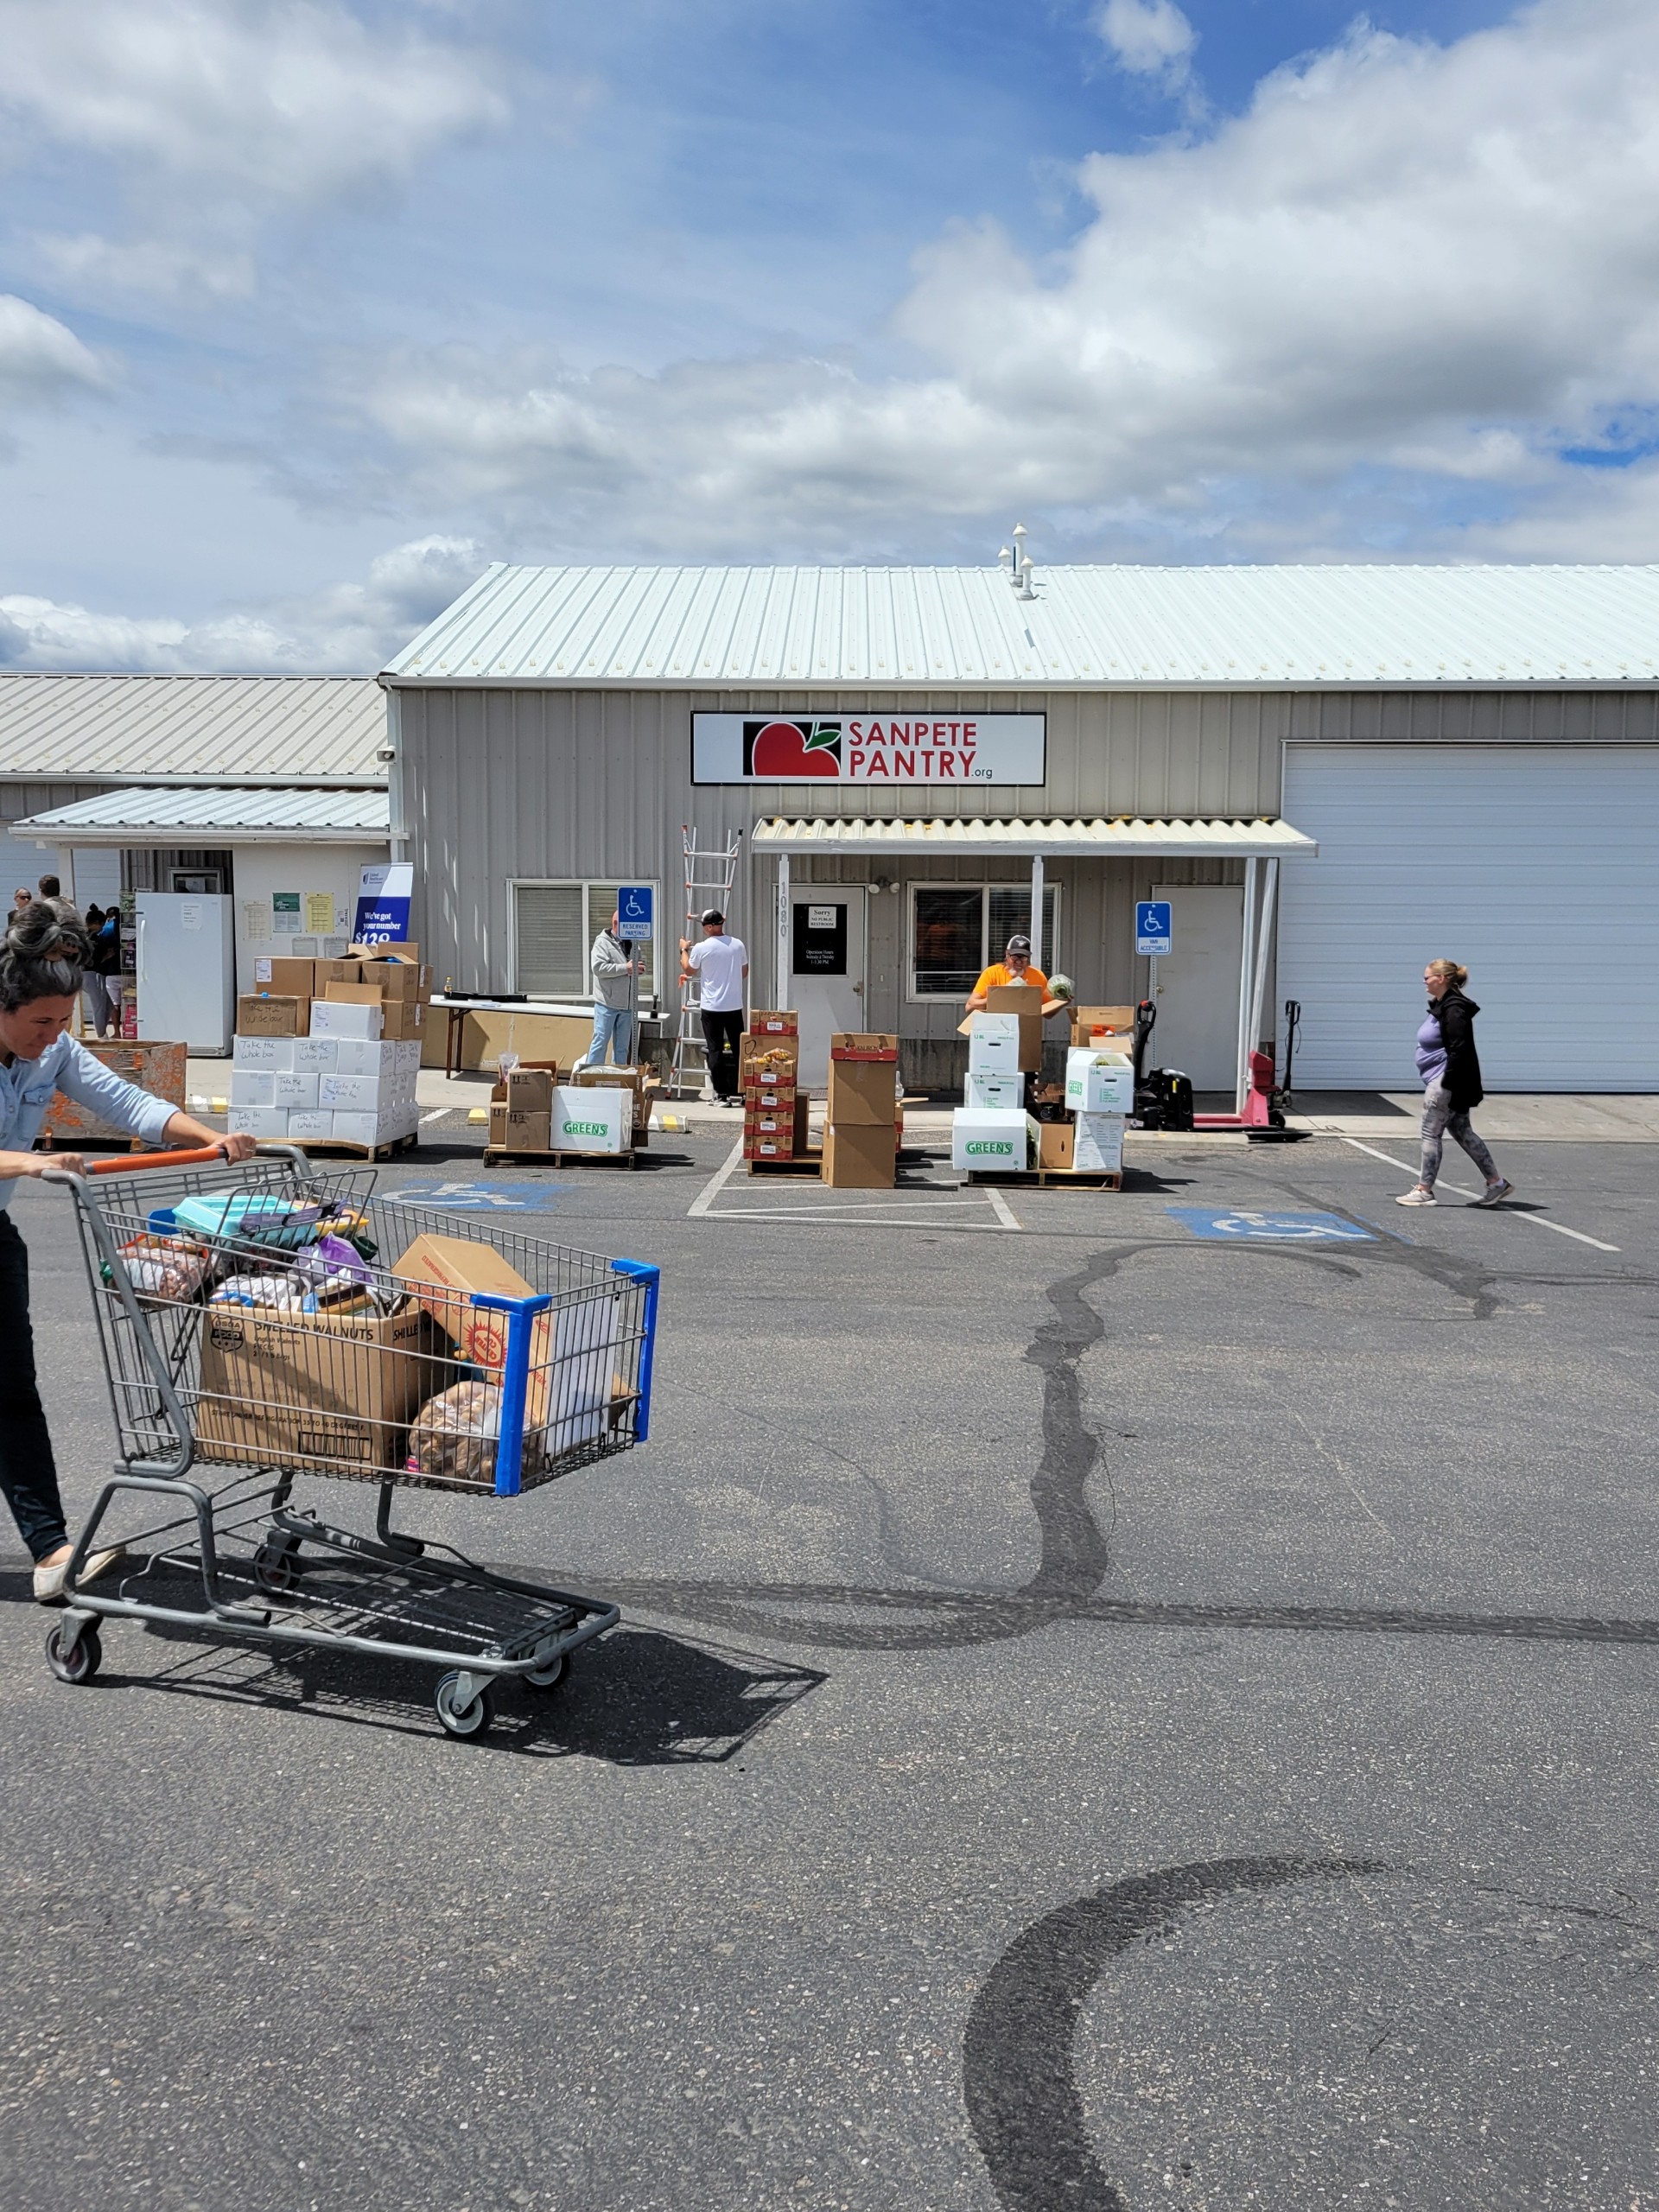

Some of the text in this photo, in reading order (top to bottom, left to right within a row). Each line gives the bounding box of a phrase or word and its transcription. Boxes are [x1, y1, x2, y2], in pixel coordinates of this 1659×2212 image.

[848, 721, 976, 747] SANPETE
[849, 750, 993, 779] PANTRY .org
[380, 912, 391, 921] got
[363, 921, 401, 931] your number
[240, 1040, 276, 1049] Take the
[318, 1042, 328, 1051] the
[241, 1049, 274, 1059] whole box
[238, 1111, 251, 1121] Take
[564, 1122, 607, 1136] GREENS
[966, 1142, 1013, 1154] GREENS
[256, 1319, 373, 1341] SHELLED WALNUTS
